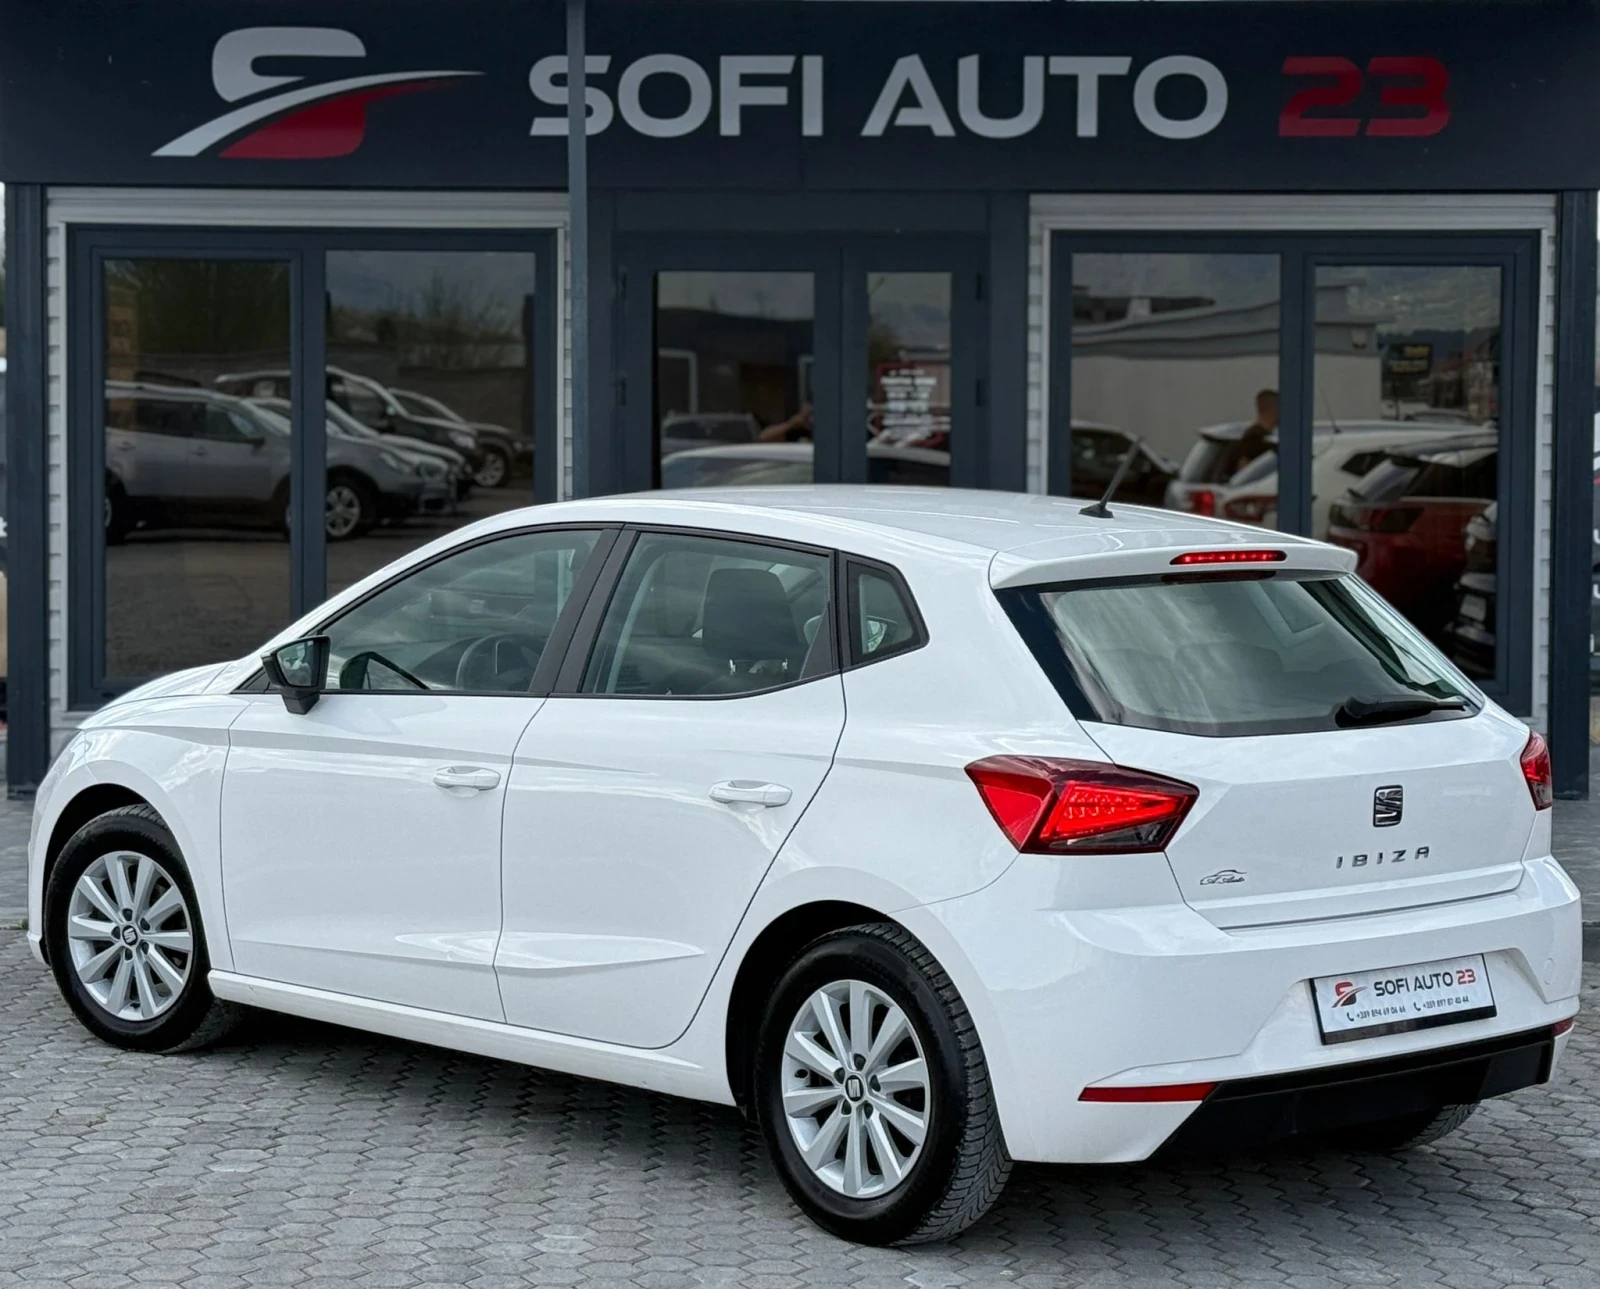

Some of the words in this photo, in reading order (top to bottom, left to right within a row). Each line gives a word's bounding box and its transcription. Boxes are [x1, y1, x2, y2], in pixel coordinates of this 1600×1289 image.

[529, 54, 823, 137] SOFI
[861, 54, 1228, 139] AUTO
[1278, 56, 1451, 138] 23
[1336, 846, 1430, 869] IBIZA
[1373, 977, 1411, 997] SOFI
[1413, 972, 1454, 992] AUTO
[1455, 968, 1477, 986] 23
